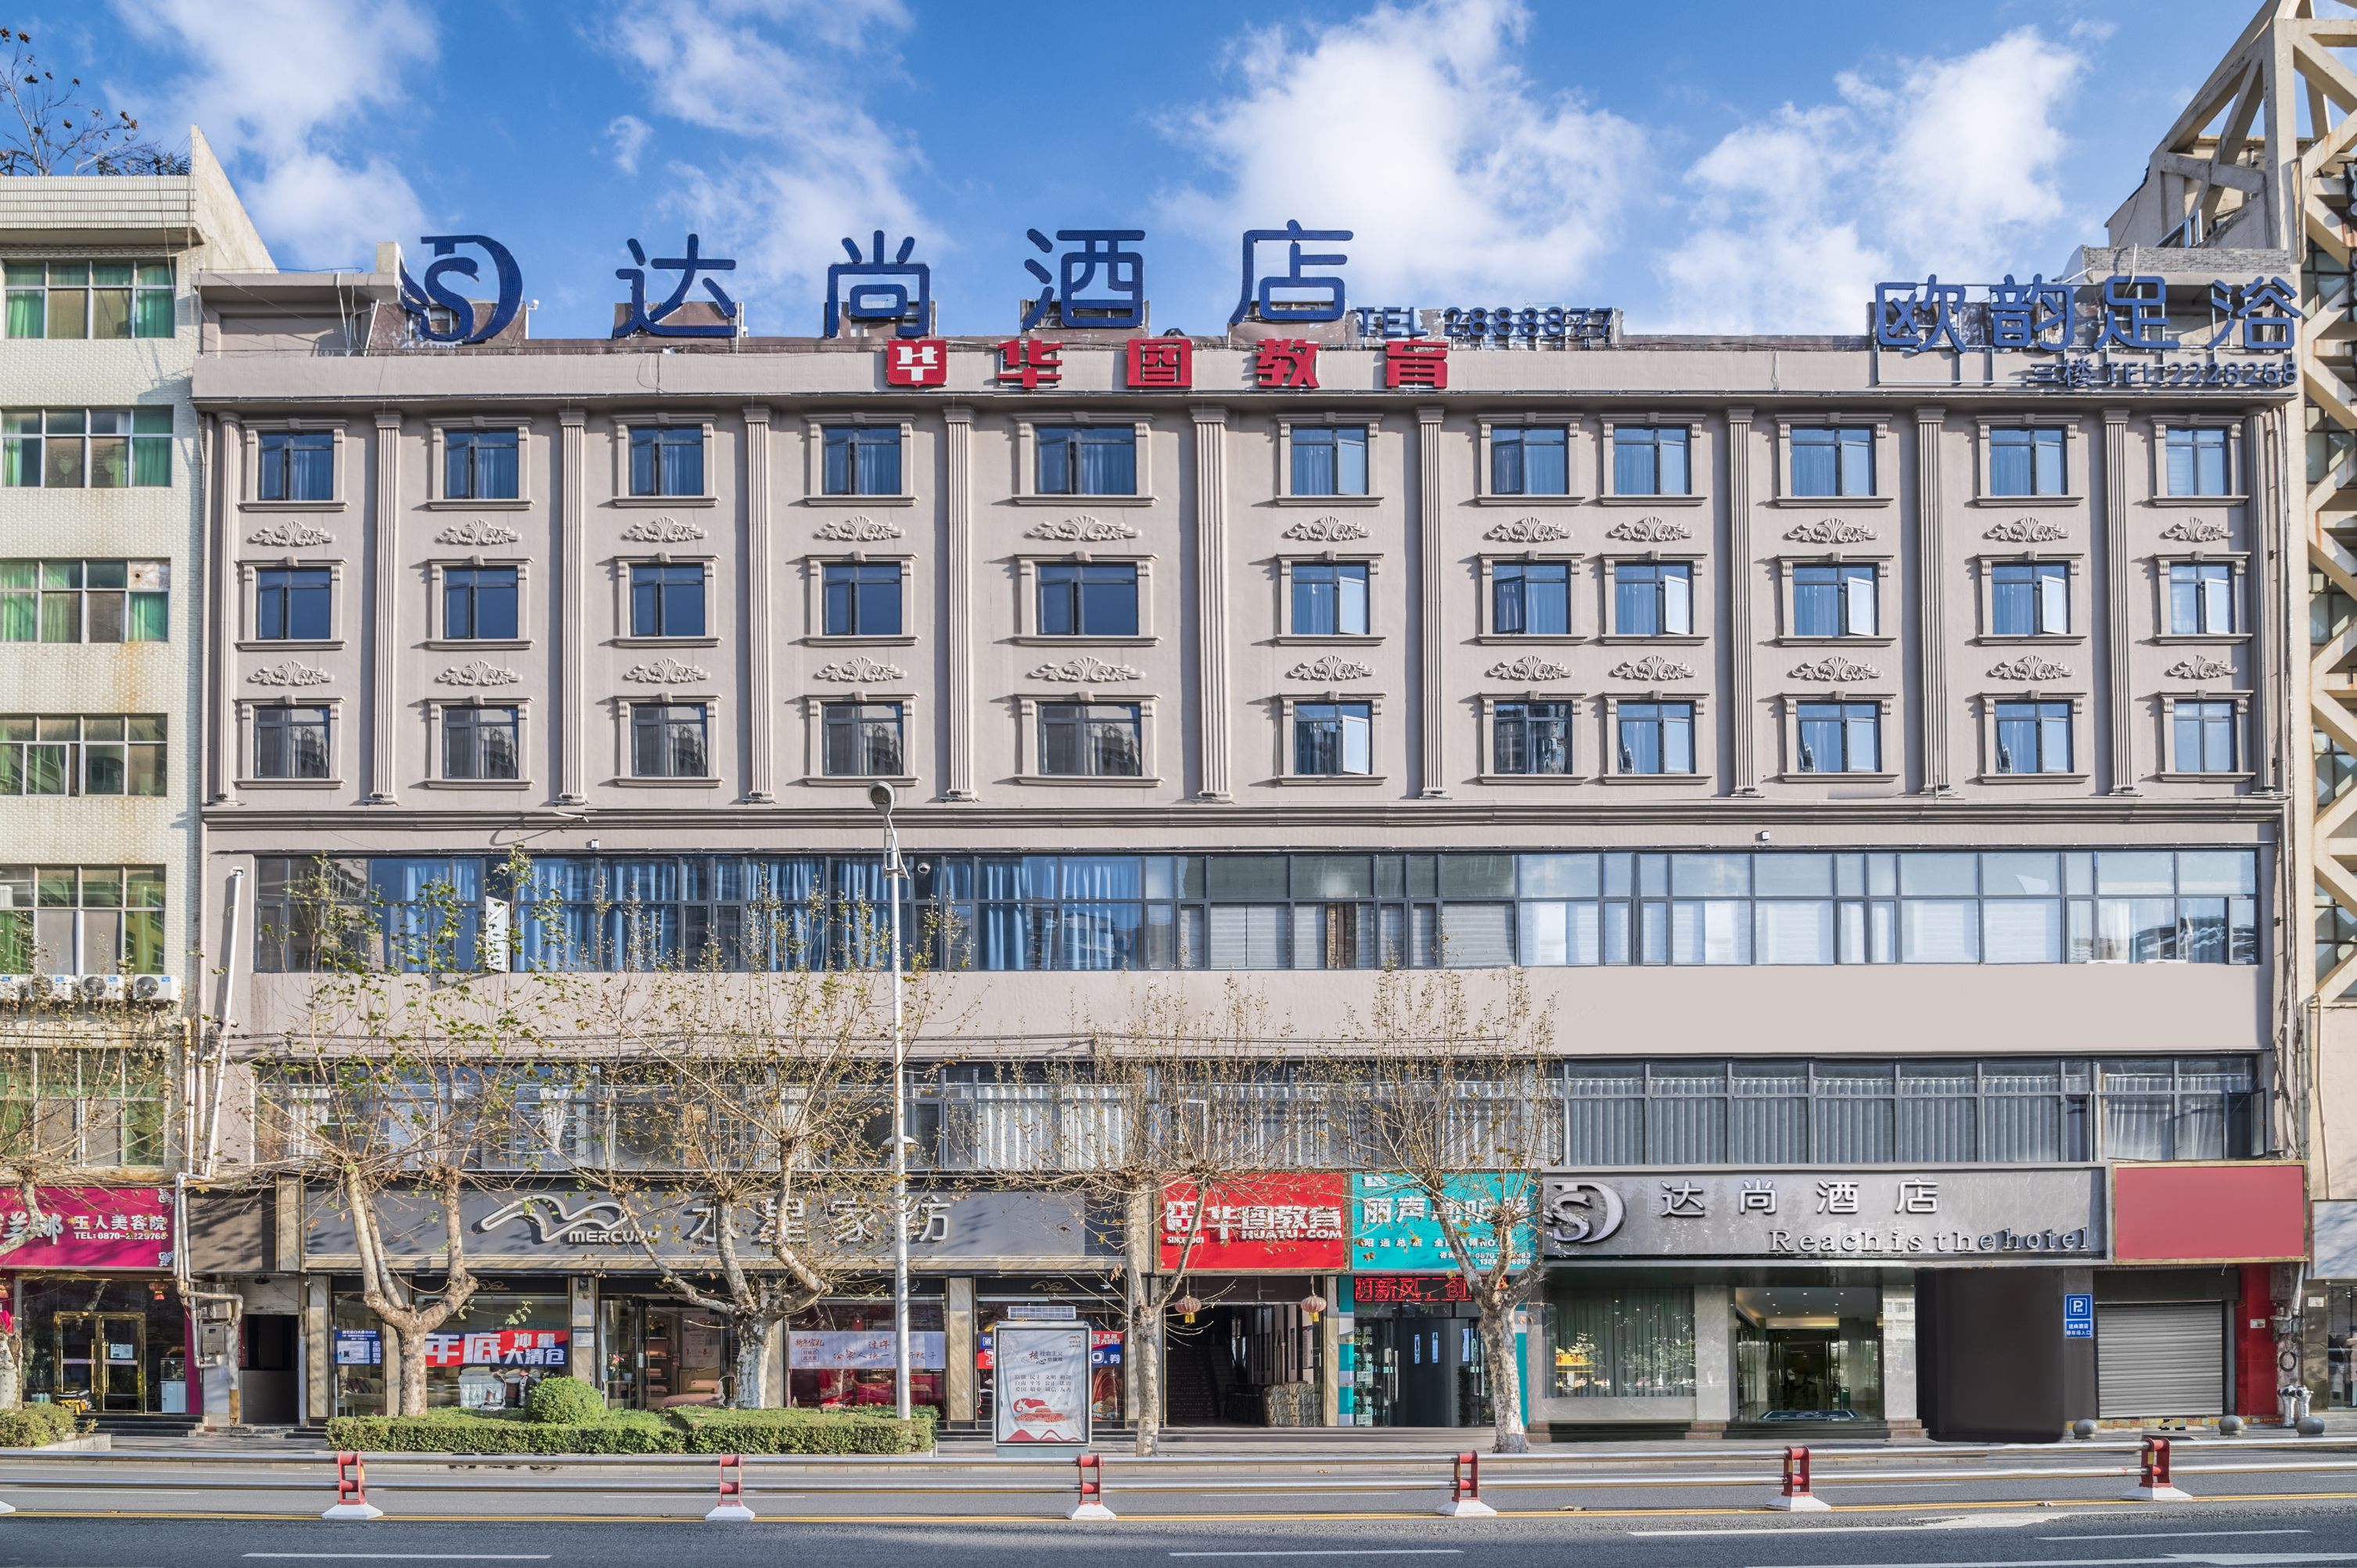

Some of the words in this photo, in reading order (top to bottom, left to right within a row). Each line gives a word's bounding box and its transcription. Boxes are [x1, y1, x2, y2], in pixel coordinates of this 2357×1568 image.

[614, 219, 1353, 338] 达尚酒店
[1356, 307, 1428, 335] TEL
[1444, 307, 1615, 336] 2888877
[1877, 274, 2301, 353] 欧韵足浴
[997, 338, 1448, 389] 华图教育
[2029, 357, 2096, 387] 三楼
[2105, 361, 2160, 384] TEL
[1661, 1179, 1939, 1217] 达尚酒店
[1206, 1206, 1342, 1239] 华图教育
[1769, 1229, 1880, 1251] Reach
[1891, 1229, 1923, 1250] is
[1932, 1229, 1996, 1250] the
[2003, 1227, 2090, 1250] hotel
[425, 1332, 501, 1364] 年底
[504, 1348, 565, 1365] 大清仓
[513, 1333, 555, 1348] 冲量
